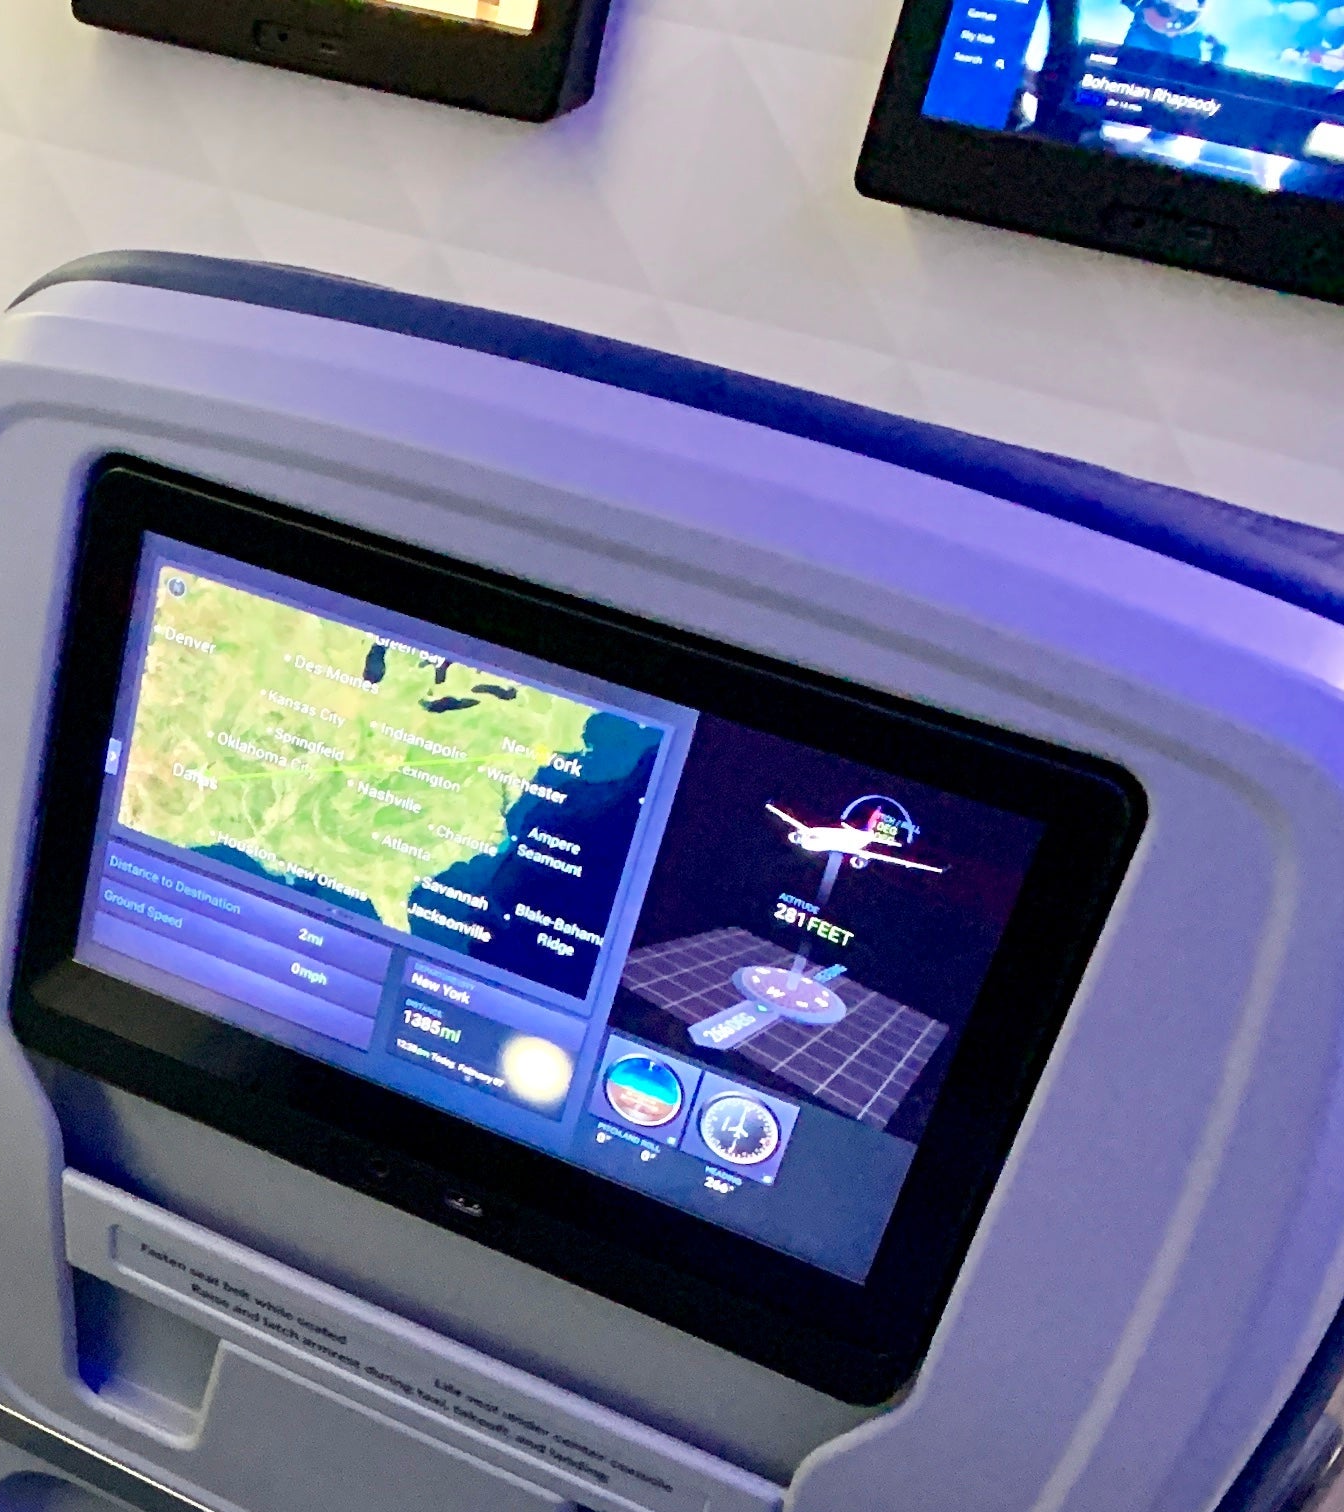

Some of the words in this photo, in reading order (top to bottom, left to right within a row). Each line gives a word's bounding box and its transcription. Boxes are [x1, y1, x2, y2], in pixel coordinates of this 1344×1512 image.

[1081, 73, 1151, 100] Bohemian
[1153, 87, 1222, 117] Rhapsody
[165, 626, 216, 656] Denver
[294, 654, 325, 677] Des
[326, 662, 380, 695] Moines
[268, 689, 316, 718] Kansas
[319, 707, 346, 728] City
[217, 731, 288, 768] Oklahoma
[274, 727, 344, 763] Springfield
[380, 721, 469, 763] Indianapolis
[357, 780, 422, 815] Nashville
[486, 765, 567, 805] Winchester
[217, 830, 278, 863] Houston
[381, 834, 432, 862] Atlanta
[436, 824, 499, 858] Charlotte
[528, 825, 582, 857] Ampere
[517, 842, 583, 879] Seamount
[109, 854, 160, 886] Distance
[161, 871, 174, 890] to
[175, 879, 242, 915] Destination
[286, 861, 315, 883] New
[316, 873, 370, 903] Orleans
[421, 875, 489, 912] Savannah
[103, 888, 145, 914] Ground
[146, 904, 184, 929] Speed
[407, 902, 493, 944] Jacksonville
[298, 926, 325, 948] 2mi
[537, 932, 575, 957] Ridge
[806, 914, 855, 947] FEET
[290, 961, 328, 986] 0mph
[411, 971, 441, 993] New
[442, 983, 471, 1005] York
[141, 1242, 187, 1272] Fasten
[254, 1298, 294, 1321] while
[232, 1304, 261, 1323] and
